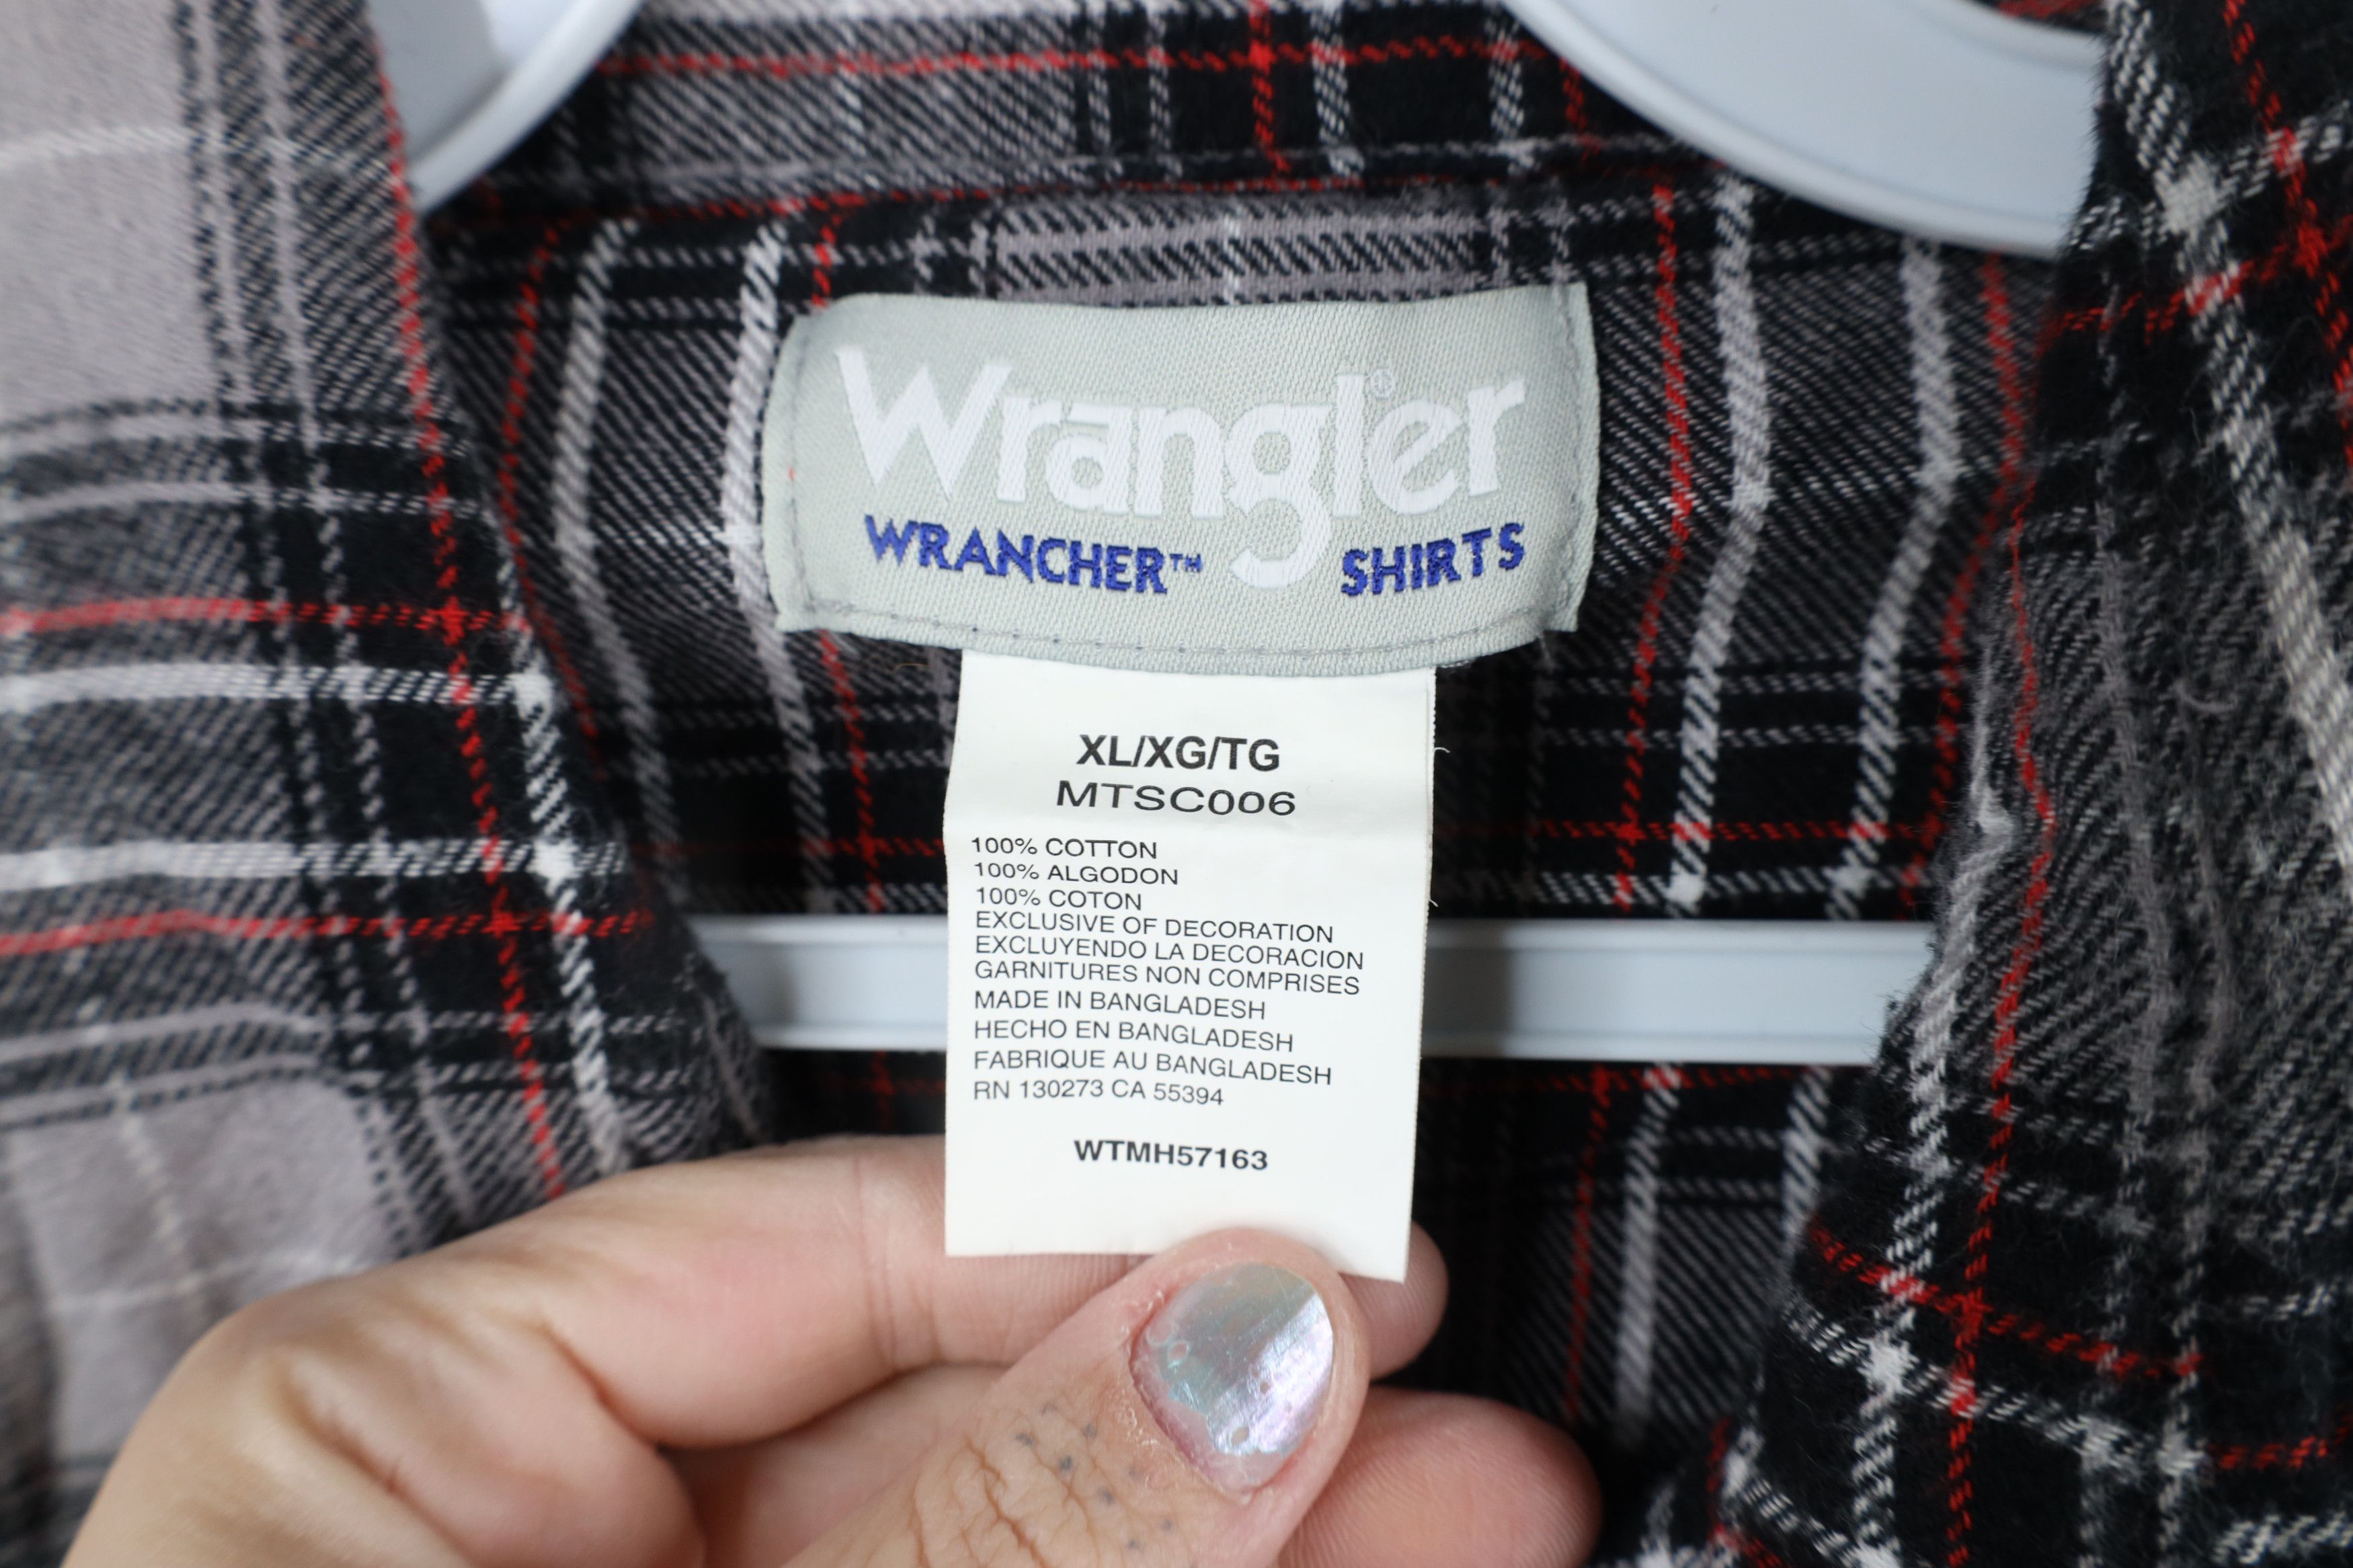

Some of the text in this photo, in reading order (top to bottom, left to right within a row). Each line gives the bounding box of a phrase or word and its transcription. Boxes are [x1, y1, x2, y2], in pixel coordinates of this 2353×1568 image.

[1341, 523, 1526, 597] SHIRTS
[1076, 734, 1280, 772] XL/XG/TG
[1056, 780, 1296, 817] MTSC006
[971, 837, 1157, 860] 100% COTTON
[974, 862, 1179, 885] 100% ALGODON
[976, 886, 1142, 911] 100% COTON
[976, 910, 1333, 944] EXCLUSIVE OF DECORATION
[975, 935, 1363, 971] EXCLUYENDO LA DECORACION
[975, 960, 1360, 995] GARNITURES NON COMPRISES
[975, 989, 1265, 1020] MADE IN BANGLADESH
[975, 1019, 1293, 1053] HECHO EN BANGLADESH
[974, 1048, 1331, 1085] FABRIQUE AU BANGLADESH
[974, 1079, 1224, 1106] RN 130273 CA 55394
[1073, 1139, 1268, 1171] WTMH57163
